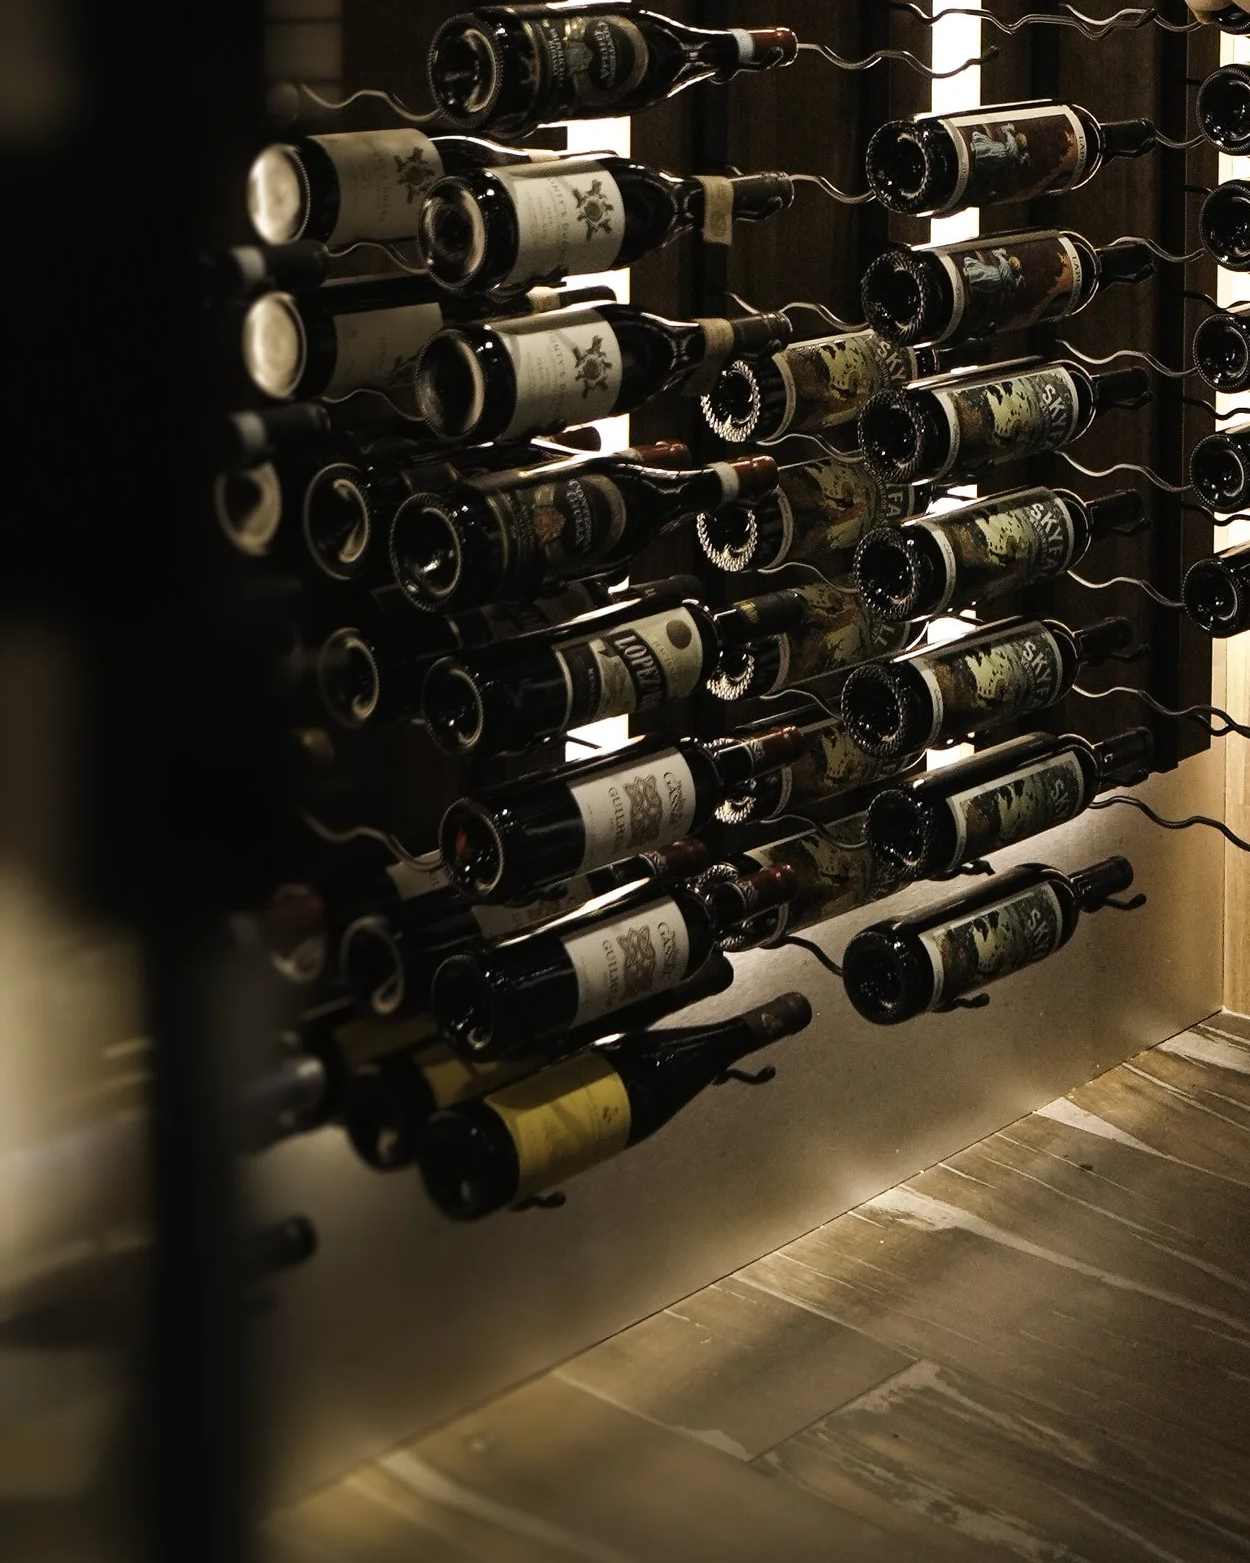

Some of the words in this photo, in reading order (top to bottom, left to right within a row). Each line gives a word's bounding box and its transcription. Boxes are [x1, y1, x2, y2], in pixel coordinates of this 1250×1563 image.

[613, 634, 663, 690] LOPEZ
[607, 786, 625, 850] GUILHE
[601, 939, 619, 1000] GUILHE
